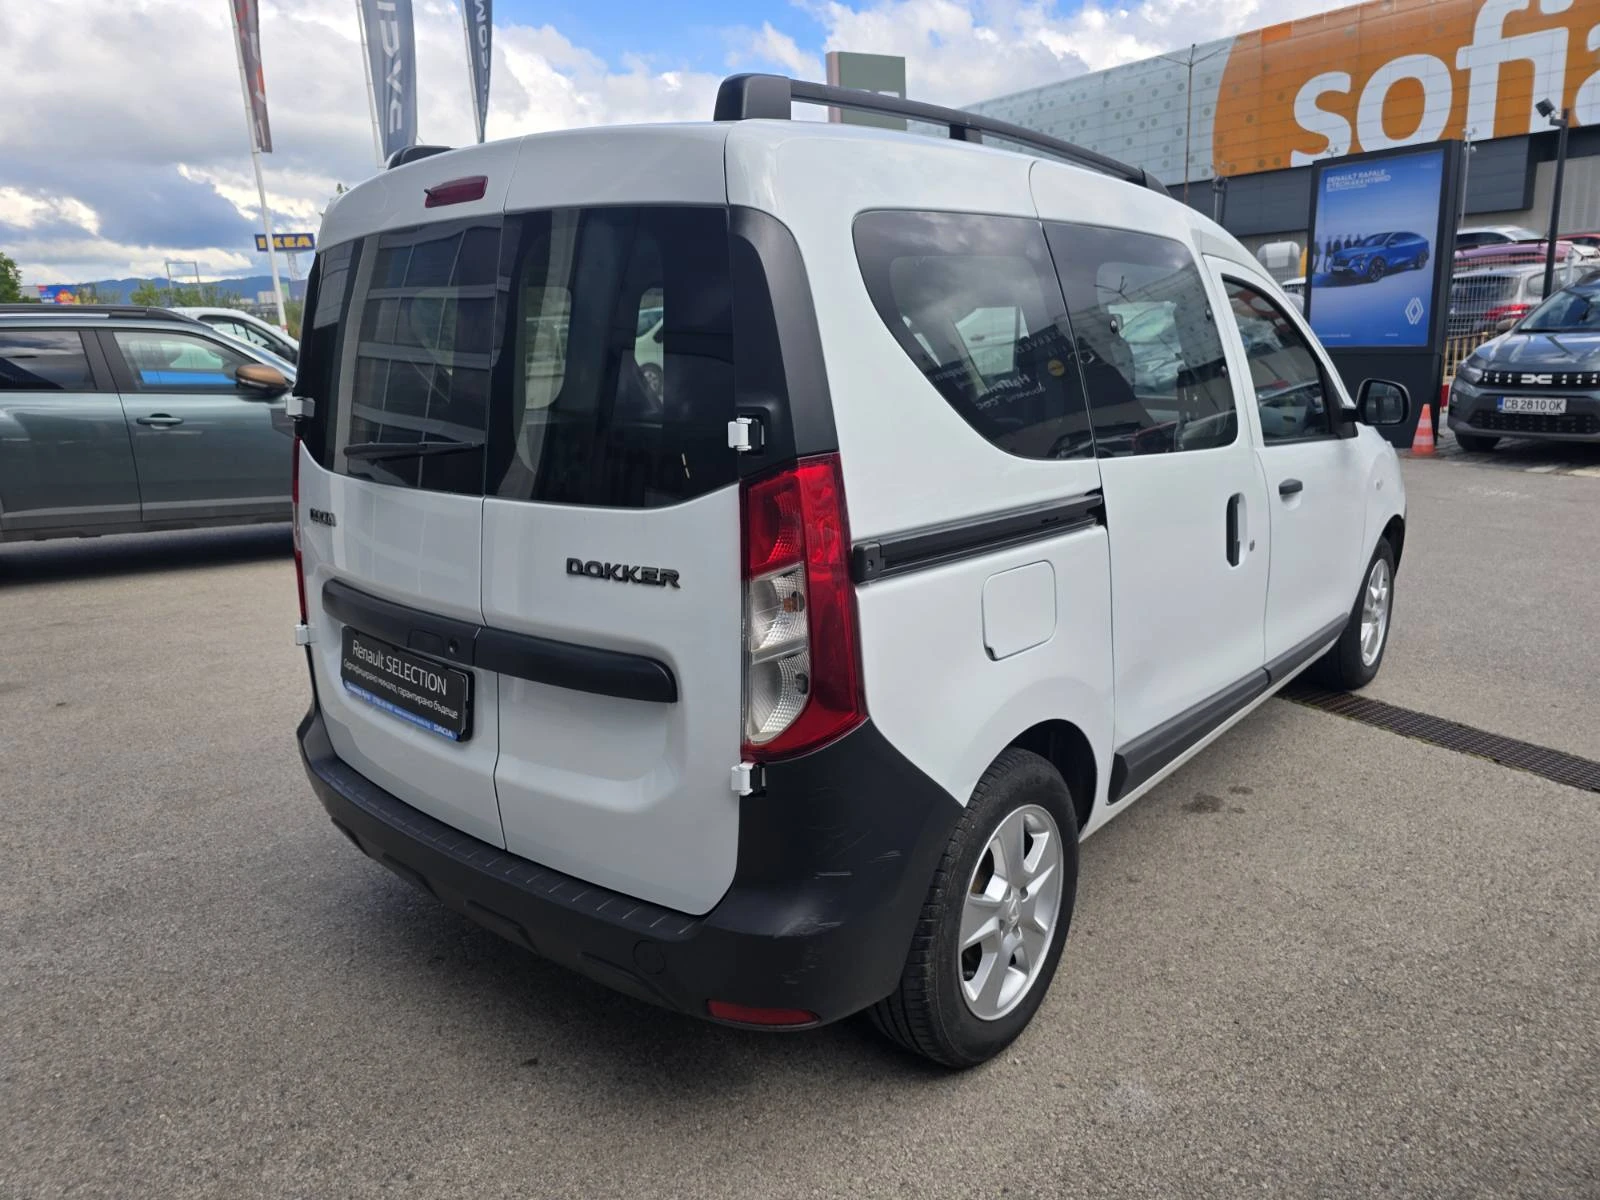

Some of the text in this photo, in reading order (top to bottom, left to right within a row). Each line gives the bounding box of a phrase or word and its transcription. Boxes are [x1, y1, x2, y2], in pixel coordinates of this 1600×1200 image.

[257, 236, 313, 249] IKEA
[1549, 401, 1564, 411] OK
[566, 557, 681, 588] DOKKER
[352, 639, 385, 670] Renault
[386, 655, 447, 696] SELECTION
